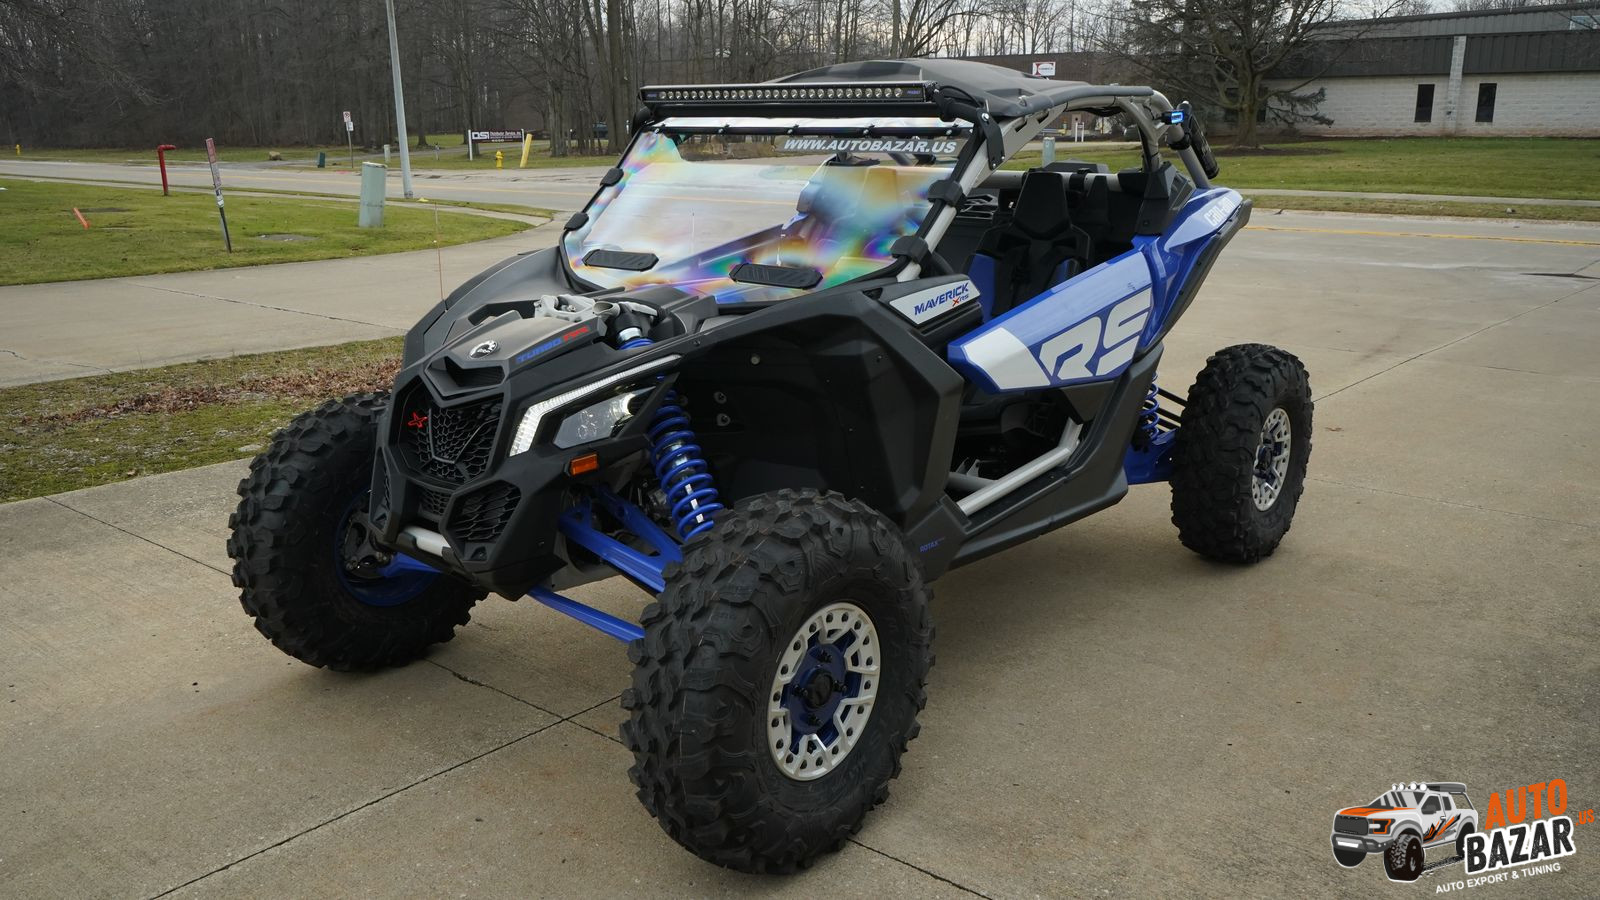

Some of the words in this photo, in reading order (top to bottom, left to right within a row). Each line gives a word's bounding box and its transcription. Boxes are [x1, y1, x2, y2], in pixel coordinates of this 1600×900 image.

[471, 131, 490, 140] DSI
[784, 139, 957, 153] WWW.AUTOBAZAR.US
[914, 282, 969, 315] MAVERICK
[1039, 287, 1151, 380] RS
[516, 337, 562, 364] TURBO
